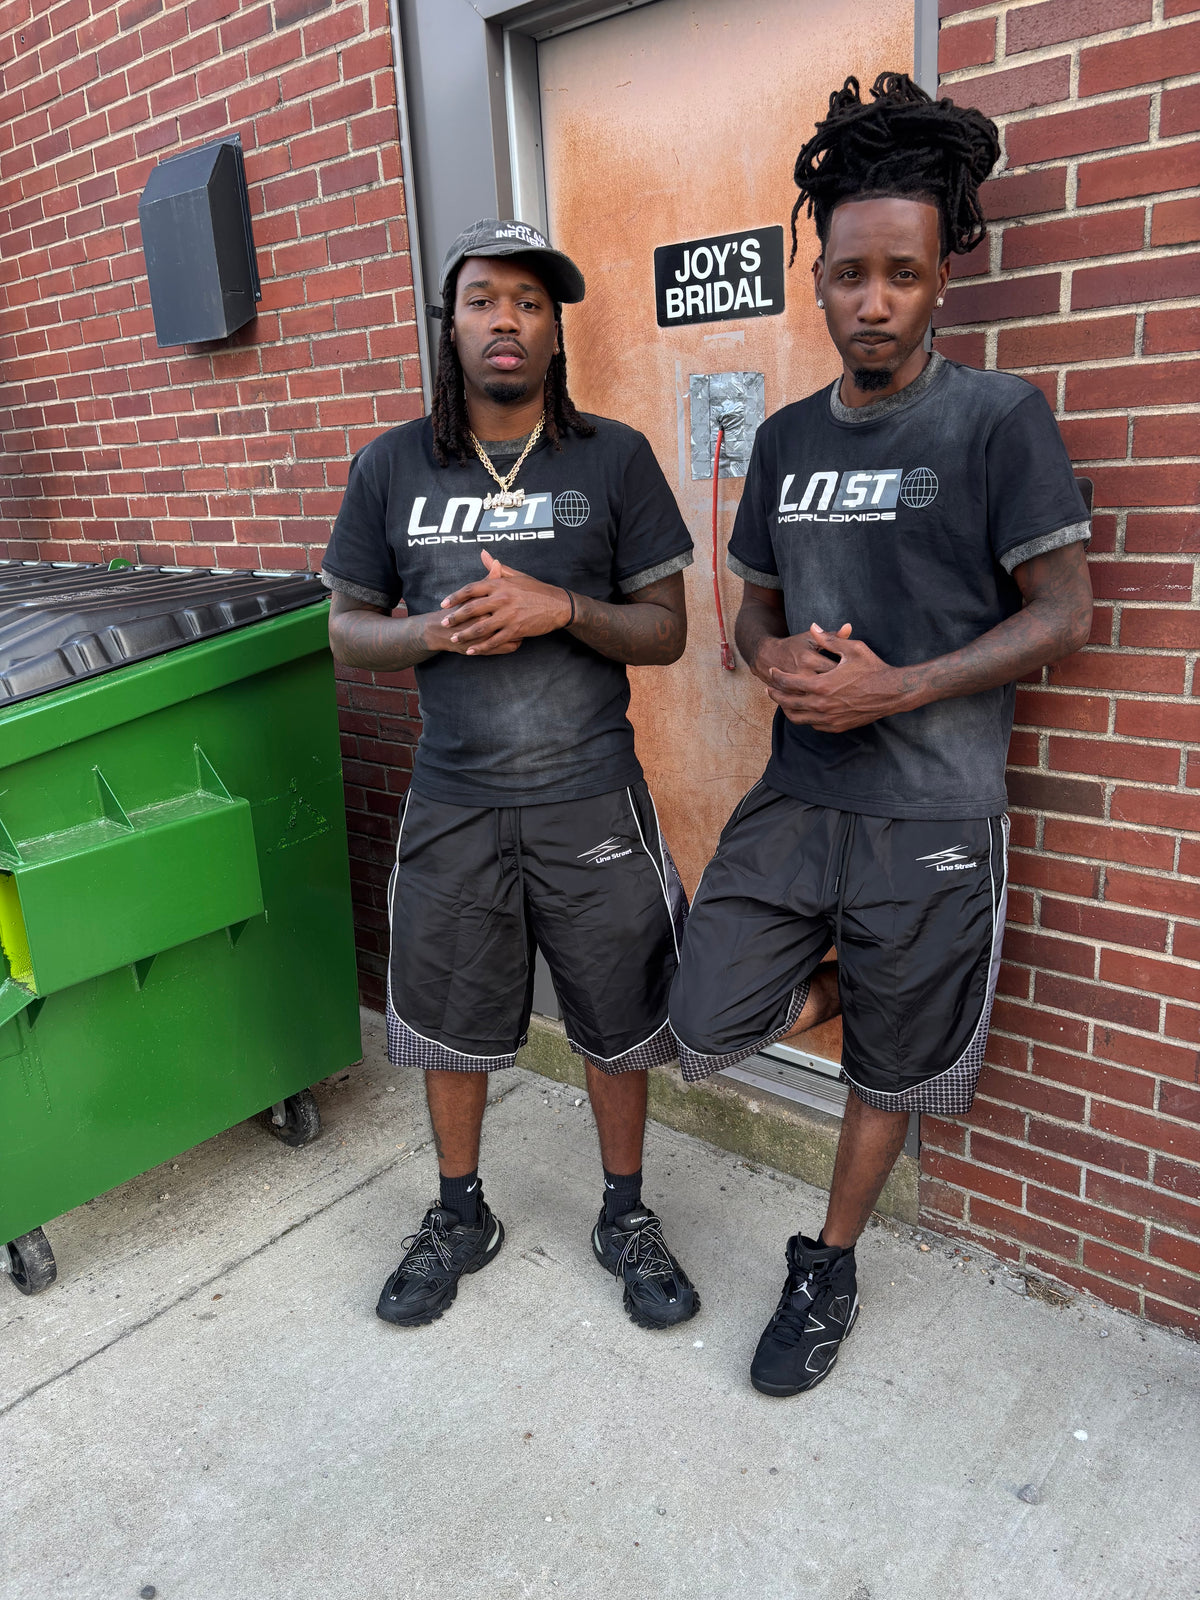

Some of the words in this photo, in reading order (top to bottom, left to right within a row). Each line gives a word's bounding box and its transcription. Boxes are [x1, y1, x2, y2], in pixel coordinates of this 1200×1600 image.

[674, 238, 761, 283] JOY'S
[665, 275, 773, 319] BRIDAL
[778, 511, 897, 524] WORLDWIDE
[408, 530, 555, 547] WORLDWIDE
[595, 855, 611, 864] Line
[611, 848, 632, 860] Street
[936, 864, 953, 872] Line
[954, 861, 977, 870] Street
